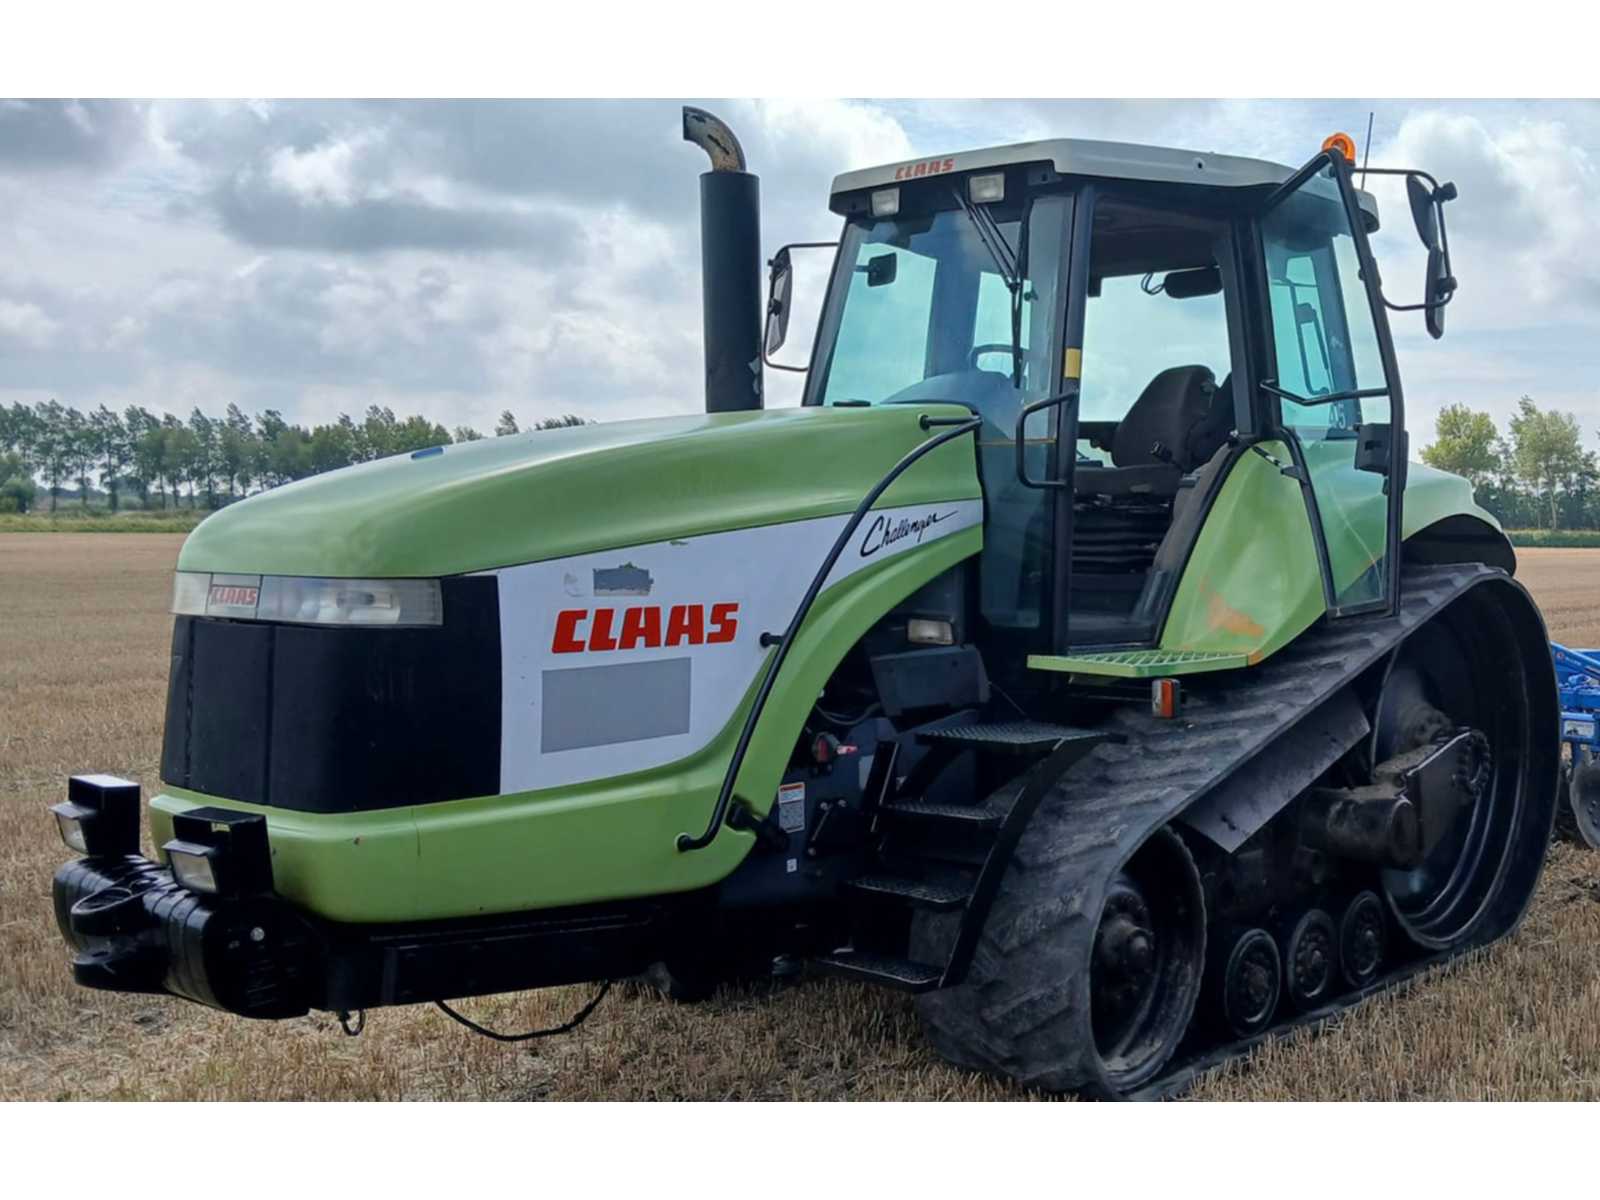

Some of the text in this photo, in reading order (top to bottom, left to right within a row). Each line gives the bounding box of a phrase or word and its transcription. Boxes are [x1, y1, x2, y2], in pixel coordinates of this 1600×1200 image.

[896, 158, 954, 180] CLAAS
[860, 510, 959, 557] Challenger
[210, 587, 258, 606] CLAAS
[552, 602, 739, 654] CLAAS
